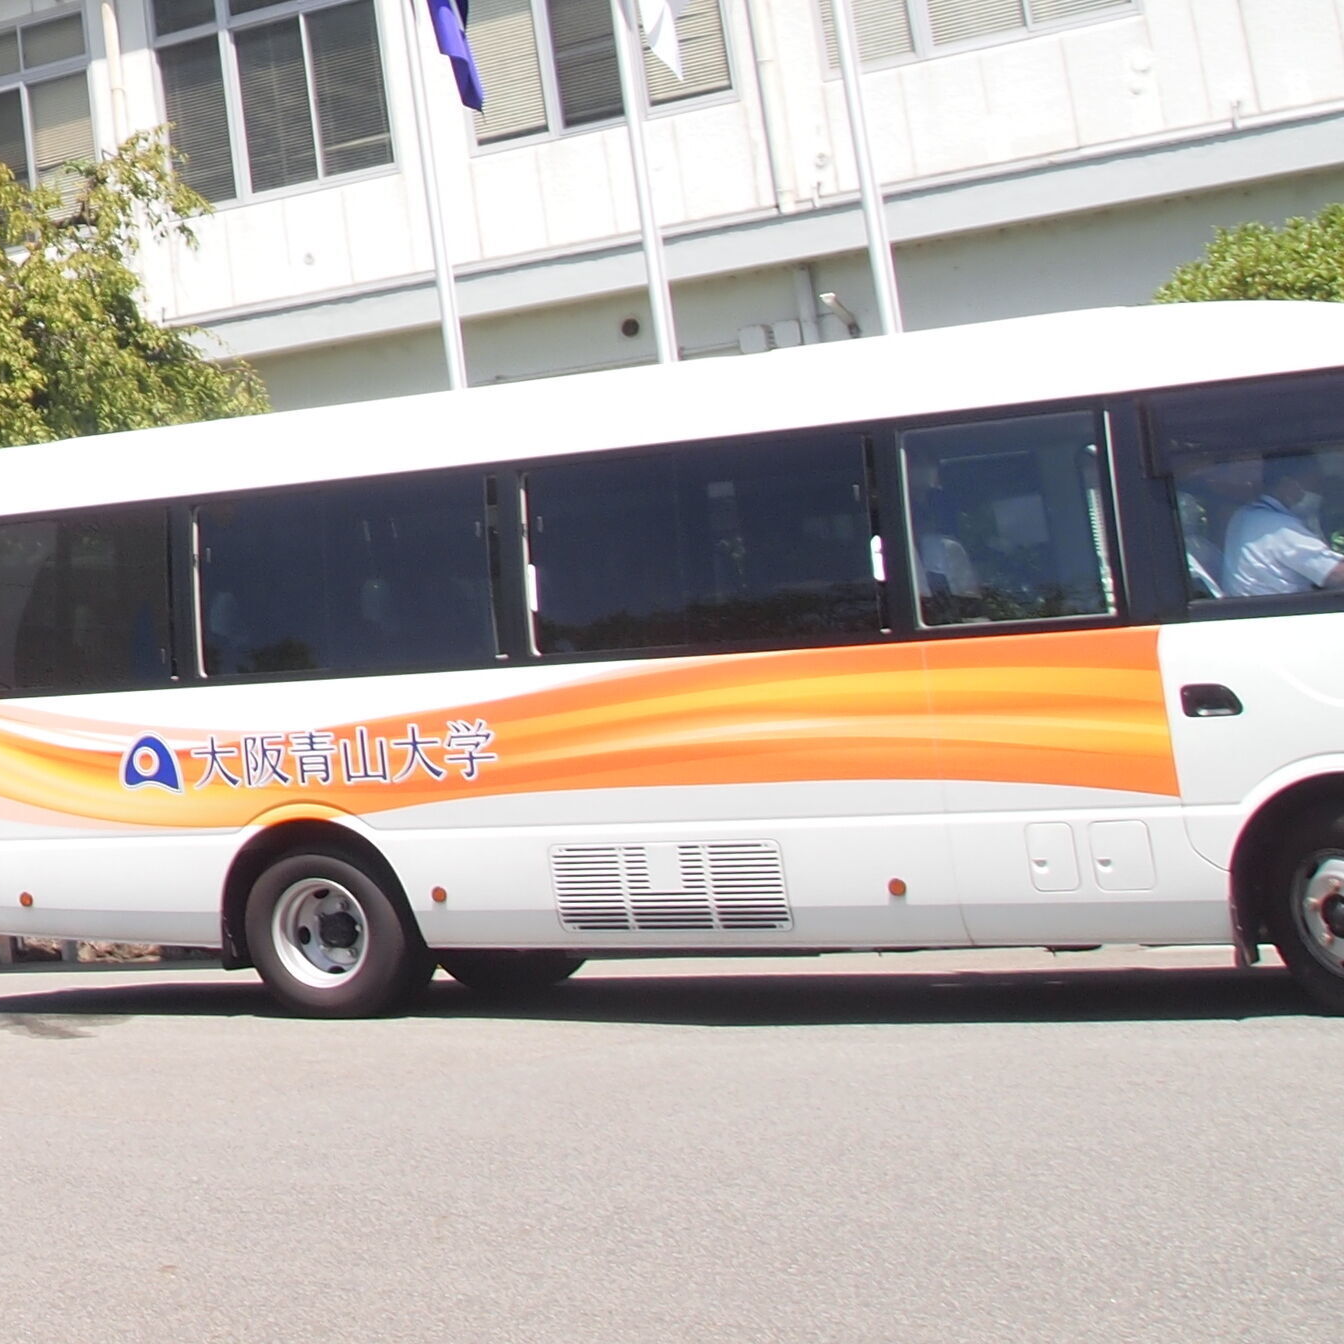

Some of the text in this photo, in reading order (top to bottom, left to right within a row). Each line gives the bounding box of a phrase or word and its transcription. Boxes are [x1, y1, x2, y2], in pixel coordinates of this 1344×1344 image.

[190, 719, 498, 788] 大阪青山大学
